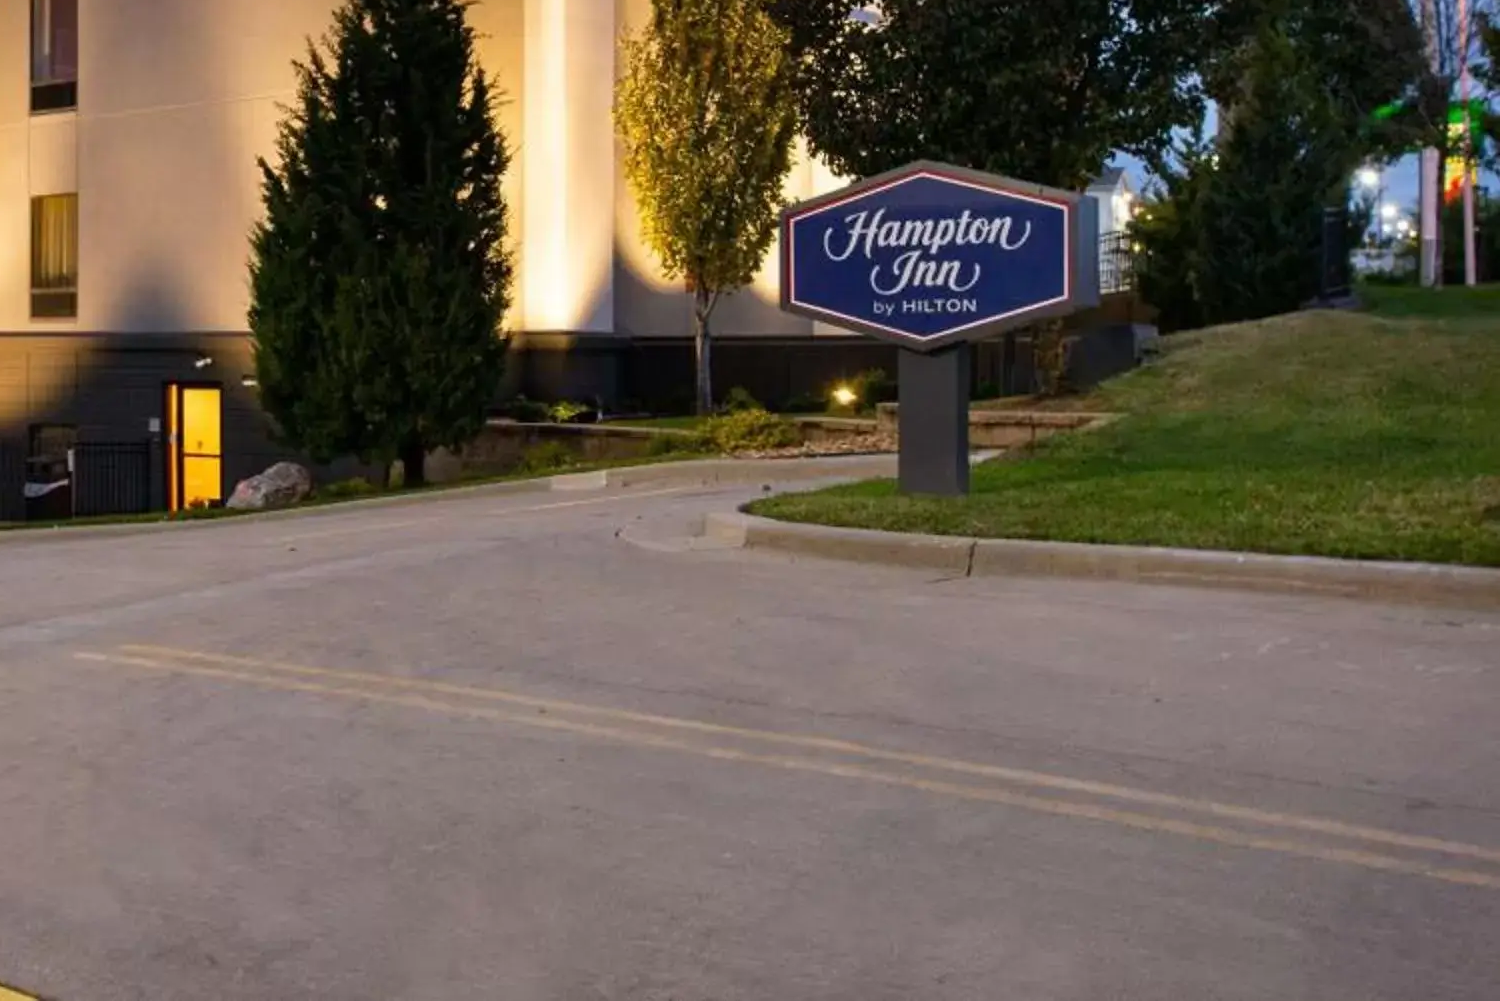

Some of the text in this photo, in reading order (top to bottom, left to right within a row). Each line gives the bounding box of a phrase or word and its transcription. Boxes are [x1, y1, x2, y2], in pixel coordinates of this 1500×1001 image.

[823, 207, 1032, 262] Hampton
[870, 250, 981, 296] Inn
[873, 298, 978, 317] by HILTON
